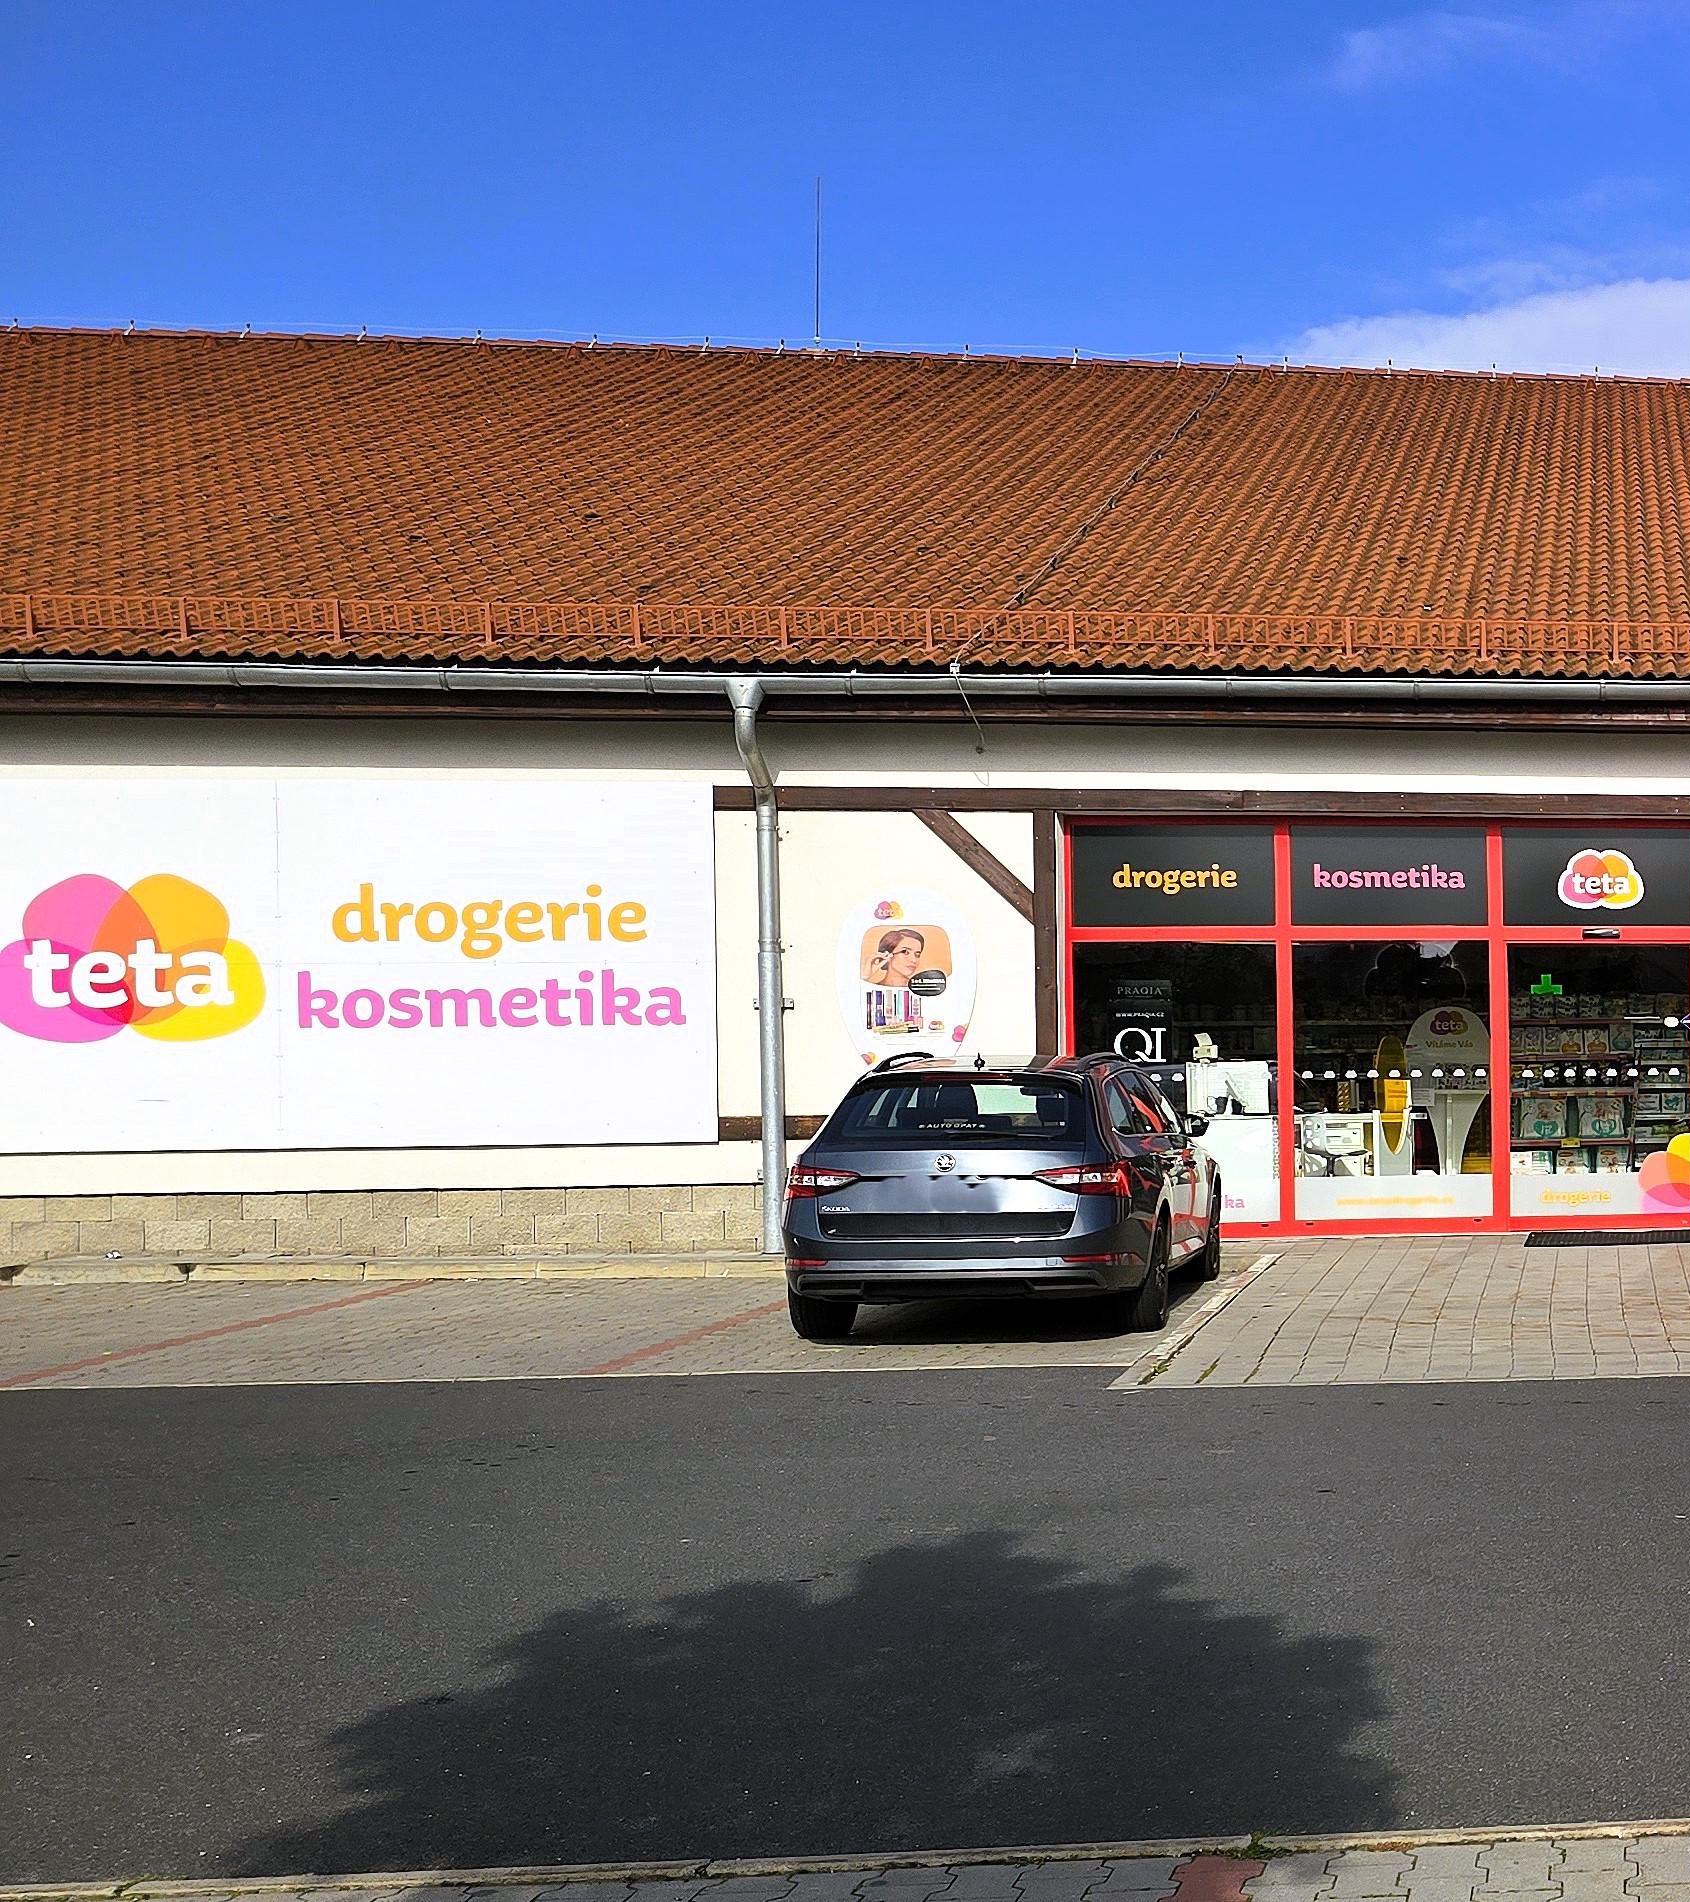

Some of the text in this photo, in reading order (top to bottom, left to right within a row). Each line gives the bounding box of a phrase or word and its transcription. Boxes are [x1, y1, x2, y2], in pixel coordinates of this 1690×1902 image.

[1112, 863, 1238, 895] drogerie
[1313, 864, 1465, 889] kosmetika
[1571, 872, 1631, 895] teta
[332, 883, 648, 958] drogerie
[23, 938, 235, 1009] teta
[297, 970, 687, 1029] kosmetika
[1117, 986, 1162, 995] PRAQIA
[1435, 1018, 1463, 1030] teta
[1113, 1027, 1167, 1063] QI
[1457, 1039, 1473, 1048] Vás
[926, 1122, 978, 1130] AUTO OPAT
[1540, 1189, 1612, 1206] drogerie
